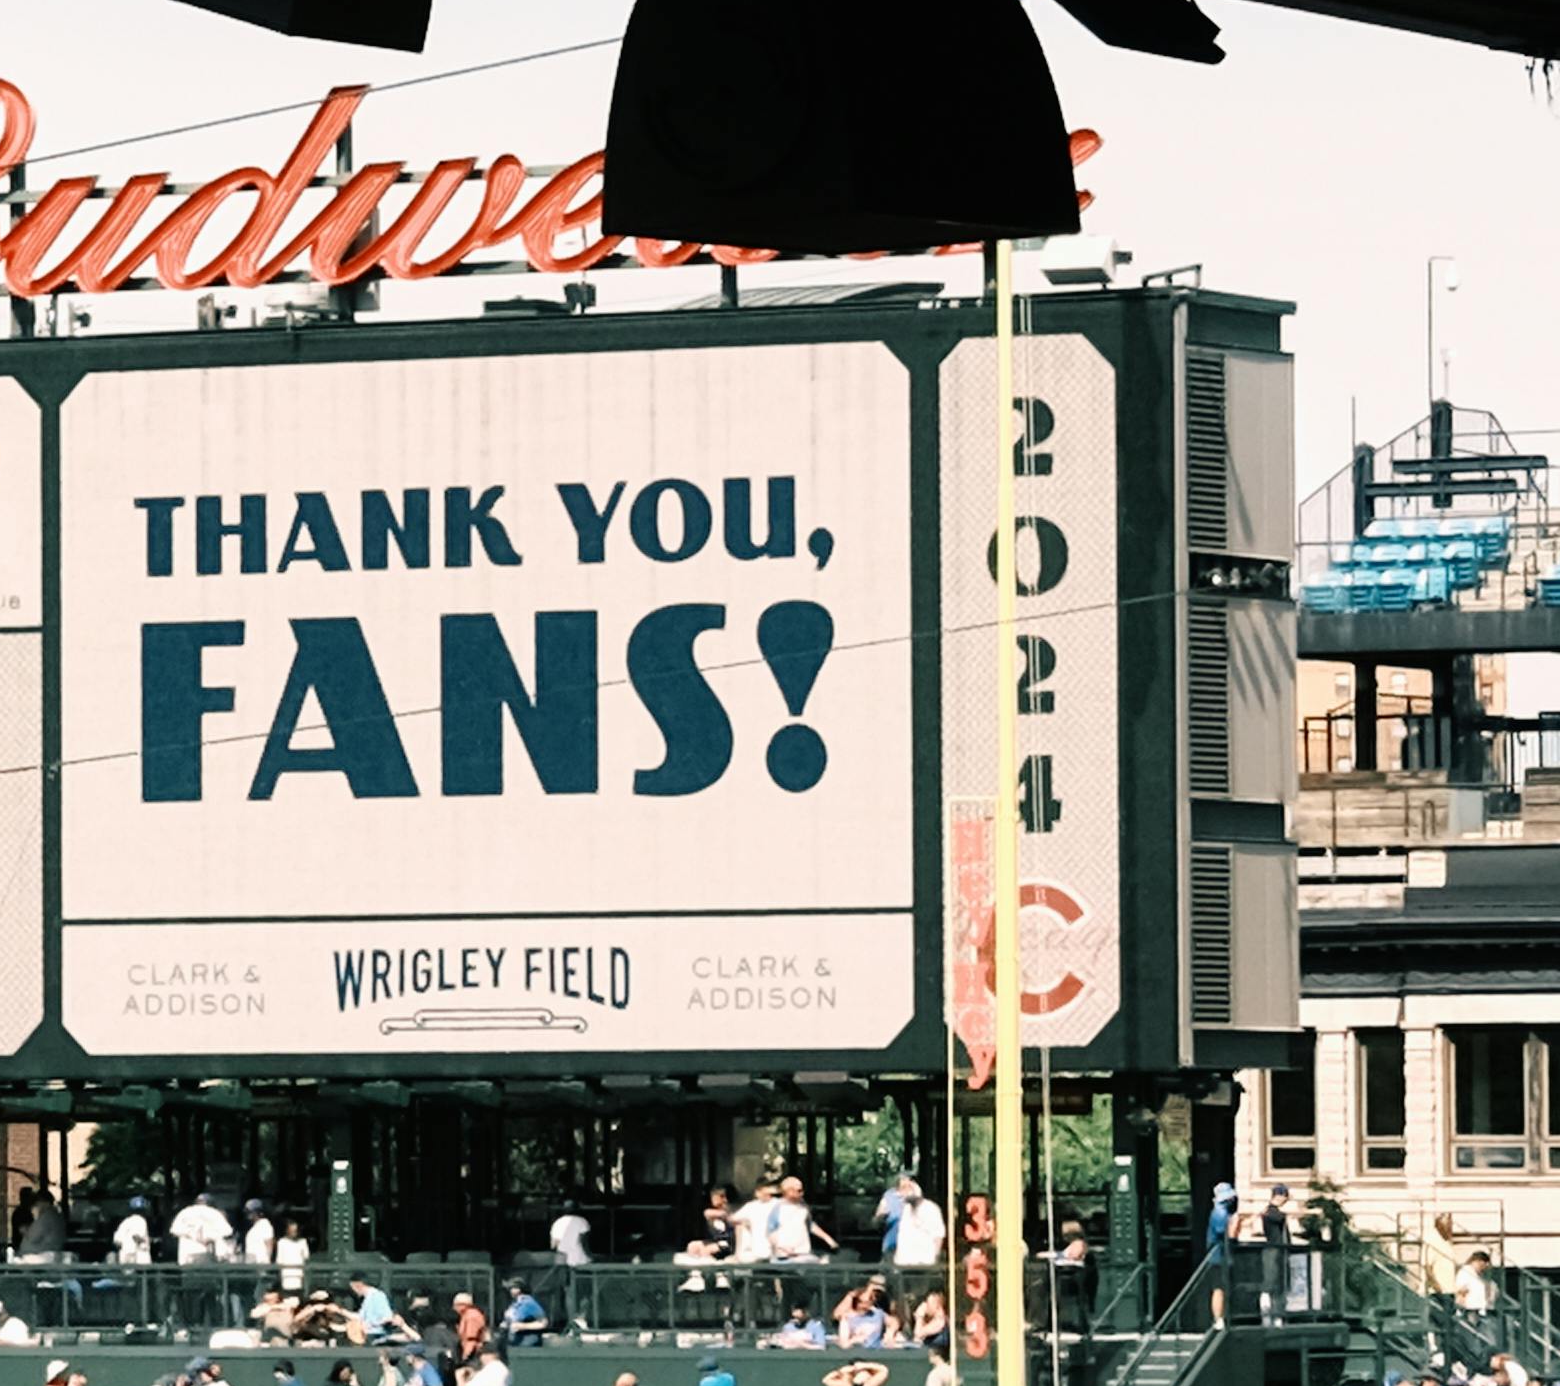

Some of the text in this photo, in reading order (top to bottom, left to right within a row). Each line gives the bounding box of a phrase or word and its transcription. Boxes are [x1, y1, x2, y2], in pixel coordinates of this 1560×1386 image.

[133, 475, 835, 577] THANK YOU,
[141, 600, 835, 803] FANS!
[127, 963, 262, 986] CLARK &
[333, 946, 630, 1014] WRIGLEY FIELD
[691, 955, 832, 980] CLARK &
[123, 993, 266, 1016] ADDISON
[687, 987, 837, 1011] ADDISON
